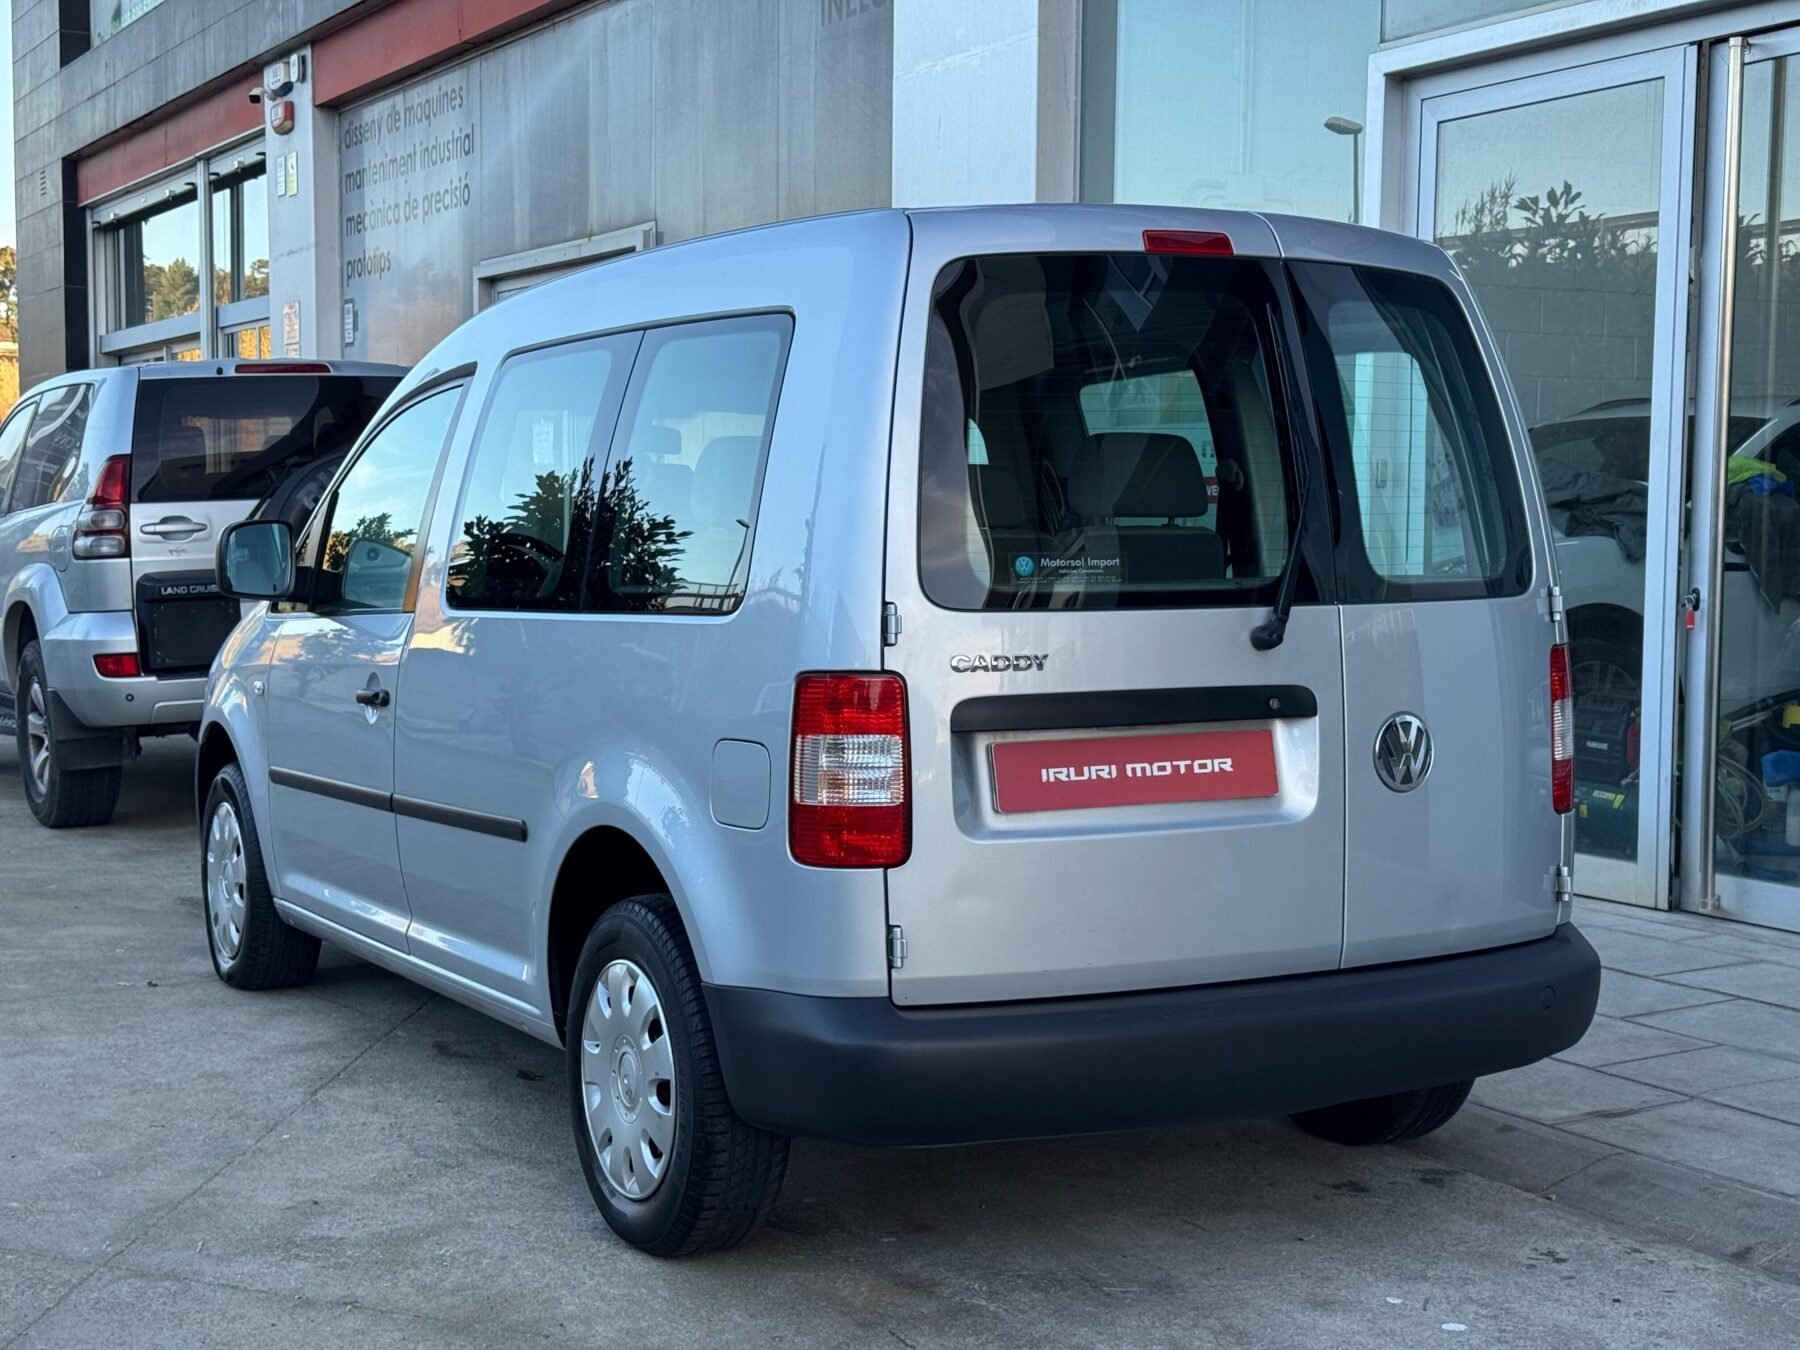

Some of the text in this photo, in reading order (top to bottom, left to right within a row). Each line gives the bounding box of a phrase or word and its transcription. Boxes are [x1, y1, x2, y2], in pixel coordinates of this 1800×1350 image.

[344, 85, 464, 150] disseny de màquines
[345, 143, 417, 194] manteniment
[420, 123, 475, 170] industrial
[345, 171, 471, 237] mecànica de precisió
[346, 247, 392, 286] prototips
[1040, 557, 1120, 569] Motorsol Import
[161, 584, 218, 595] LAND CRUIS
[950, 653, 1050, 673] CADDY
[1041, 757, 1234, 783] IRURI MOTOR
